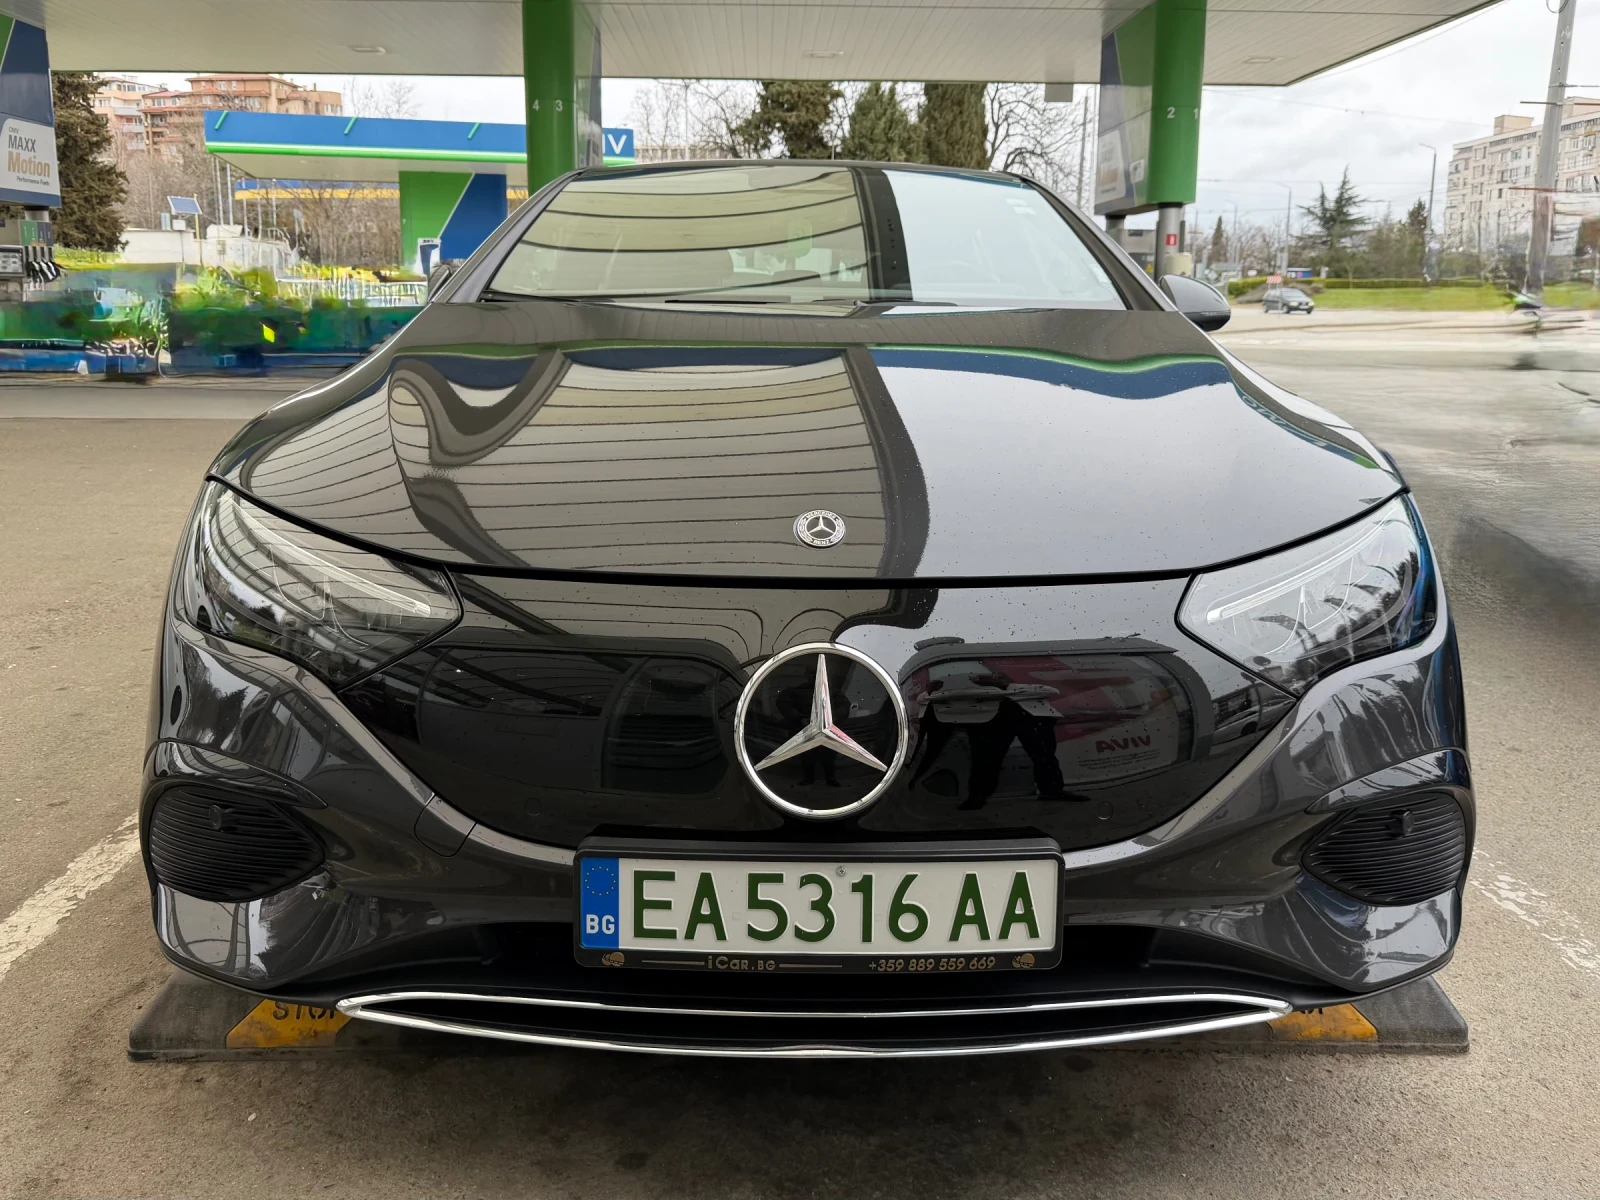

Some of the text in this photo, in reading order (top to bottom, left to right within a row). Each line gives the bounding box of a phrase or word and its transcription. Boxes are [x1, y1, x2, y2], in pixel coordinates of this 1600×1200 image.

[532, 99, 563, 112] 4 3
[1166, 106, 1200, 119] 2 1
[8, 134, 36, 153] MAXX
[8, 151, 51, 177] Motion
[633, 870, 1041, 943] EA 5316 AA
[585, 914, 616, 935] BG
[868, 956, 996, 972] +359 889 559 669
